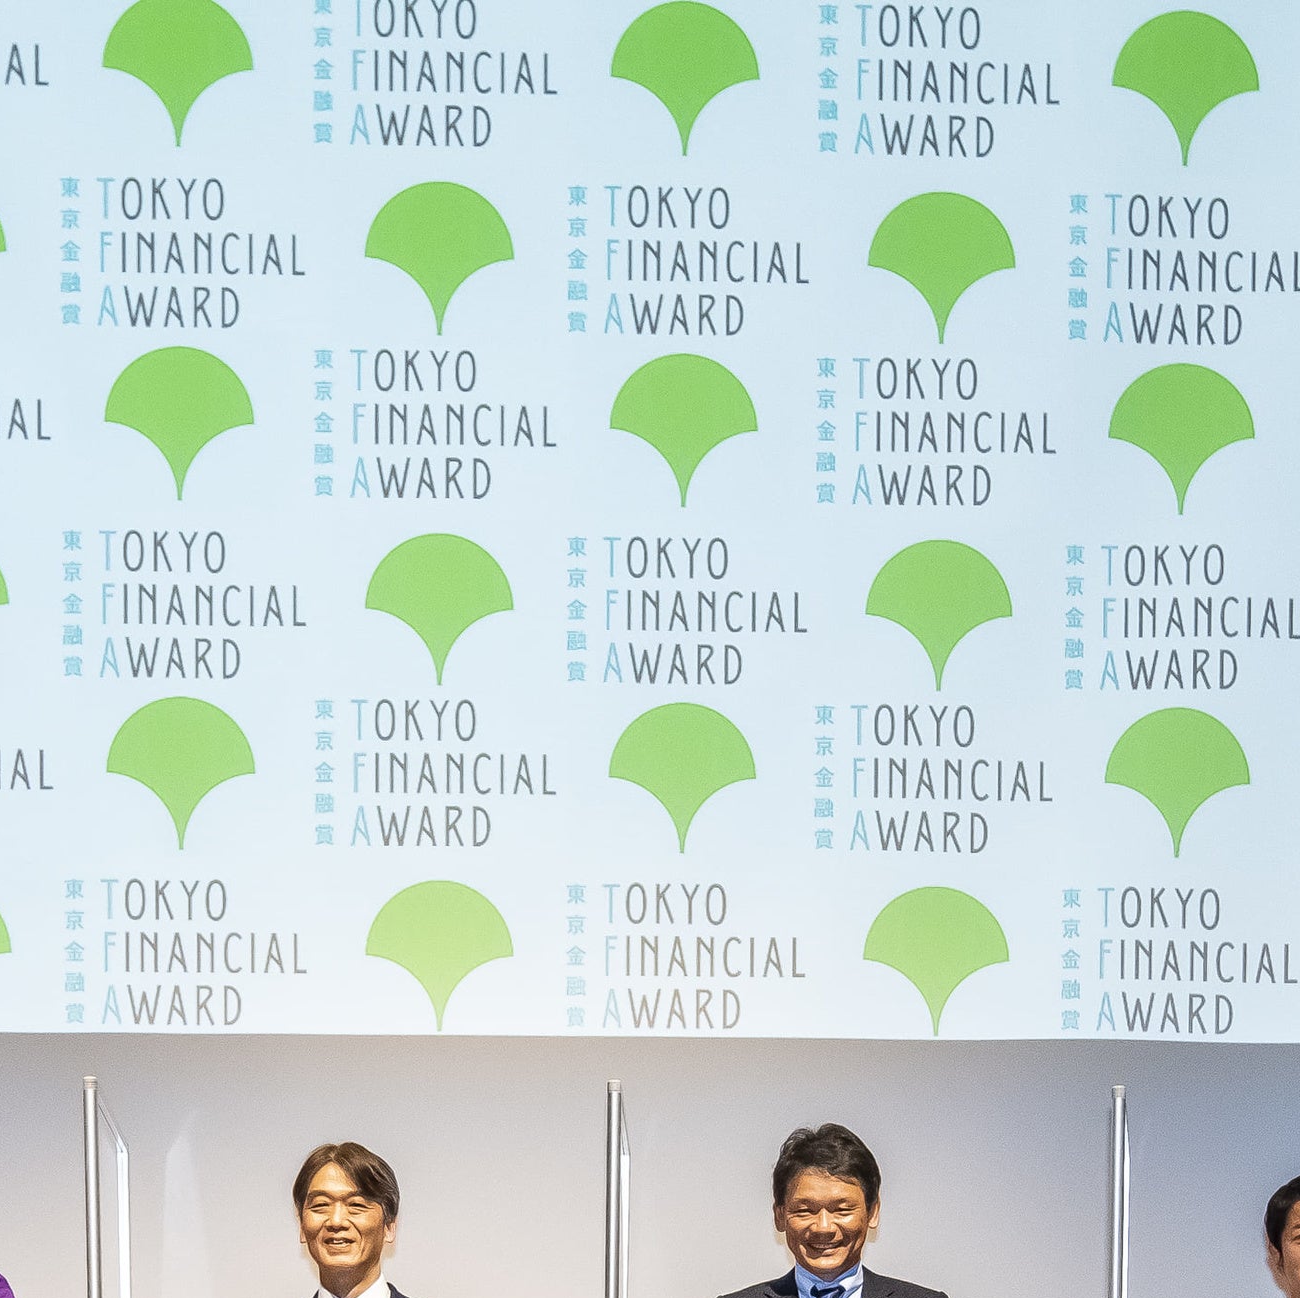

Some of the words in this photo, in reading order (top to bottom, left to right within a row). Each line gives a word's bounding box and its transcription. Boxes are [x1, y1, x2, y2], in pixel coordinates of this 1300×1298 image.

[356, 0, 477, 40] TOKYO
[854, 3, 981, 51] TOKYO
[351, 49, 558, 95] FINANCIAL
[817, 3, 839, 153] 東京金融賞
[857, 58, 1060, 106] FINANCIAL
[349, 103, 492, 147] AWARD
[854, 112, 994, 158] AWARD
[96, 176, 225, 221] TOKYO
[603, 184, 730, 230] TOKYO
[1104, 193, 1229, 240] TOKYO
[60, 176, 82, 325] 東京金融賞
[100, 231, 306, 276] FINANCIAL
[567, 185, 588, 333] 東京金融賞
[606, 238, 810, 284] FINANCIAL
[1068, 193, 1088, 341] 東京金融賞
[97, 284, 240, 329] AWARD
[604, 293, 744, 336] AWARD
[1103, 301, 1243, 346] AWARD
[349, 348, 477, 393] TOKYO
[852, 357, 978, 401] TOKYO
[314, 348, 334, 496] 東京金融賞
[352, 403, 557, 448] FINANCIAL
[816, 357, 836, 504] 東京金融賞
[855, 410, 1057, 455] FINANCIAL
[350, 456, 491, 500] AWARD
[852, 464, 991, 506] AWARD
[99, 529, 226, 574] TOKYO
[603, 536, 729, 580] TOKYO
[1101, 543, 1225, 587] TOKYO
[62, 530, 83, 677] 東京金融賞
[102, 582, 307, 627] FINANCIAL
[566, 536, 587, 682] 東京金融賞
[606, 589, 808, 633] FINANCIAL
[1064, 544, 1085, 690] 東京金融賞
[99, 636, 241, 680] AWARD
[603, 642, 743, 685] AWARD
[1099, 648, 1238, 691] AWARD
[350, 698, 477, 742] TOKYO
[850, 703, 975, 748] TOKYO
[315, 698, 334, 845] 東京金融賞
[353, 752, 557, 796] FINANCIAL
[814, 705, 835, 849] 東京金融賞
[853, 757, 1053, 802] FINANCIAL
[350, 805, 491, 847] AWARD
[850, 810, 988, 854] AWARD
[100, 878, 227, 922] TOKYO
[602, 882, 727, 926] TOKYO
[1097, 886, 1220, 931] TOKYO
[64, 879, 85, 1023] 東京金融賞
[104, 931, 307, 974] FINANCIAL
[566, 884, 586, 1026] 東京金融賞
[605, 935, 806, 978] FINANCIAL
[1061, 888, 1081, 1030] 東京金融賞
[1099, 939, 1298, 984] FINANCIAL
[102, 984, 242, 1026] AWARD
[603, 988, 740, 1029] AWARD
[1096, 991, 1233, 1035] AWARD
